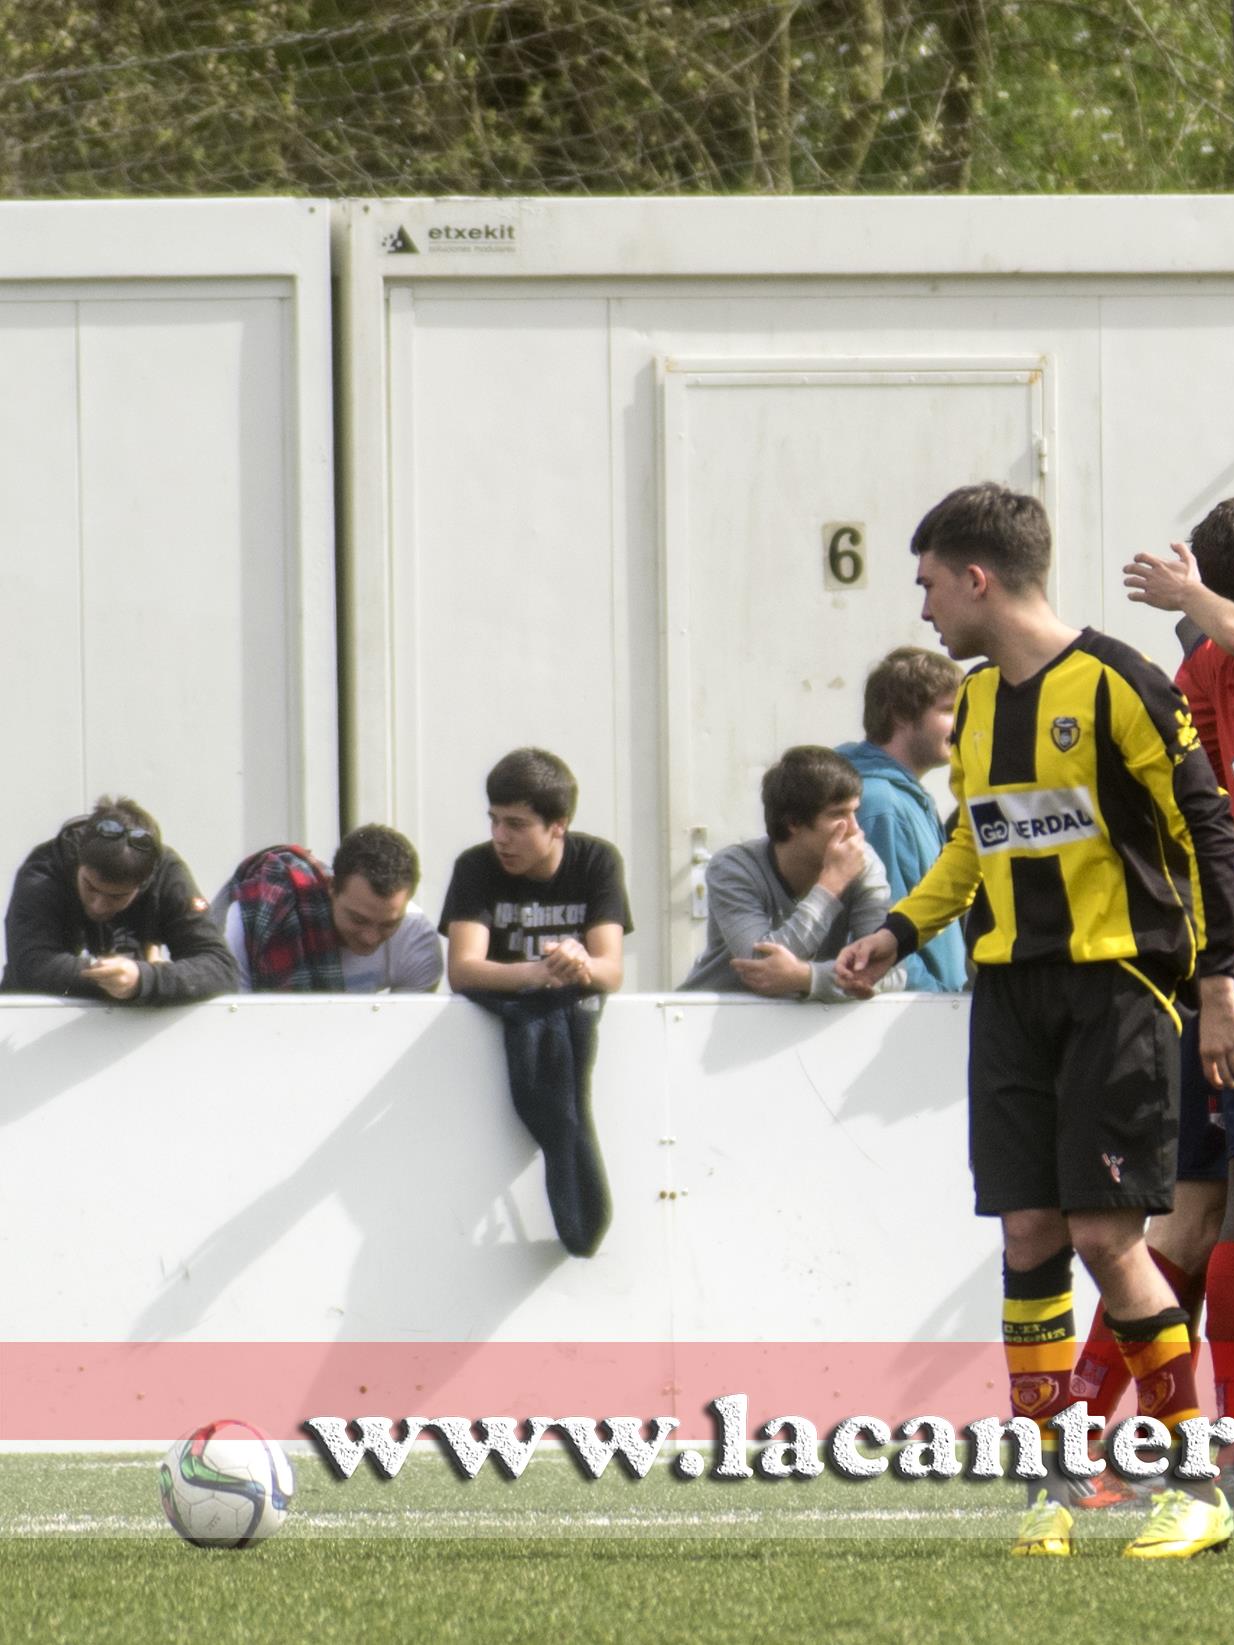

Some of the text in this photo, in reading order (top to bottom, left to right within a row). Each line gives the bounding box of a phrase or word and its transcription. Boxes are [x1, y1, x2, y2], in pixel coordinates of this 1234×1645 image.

[428, 224, 516, 240] etxekit
[828, 526, 864, 585] 6
[1014, 808, 1095, 840] ERDAU
